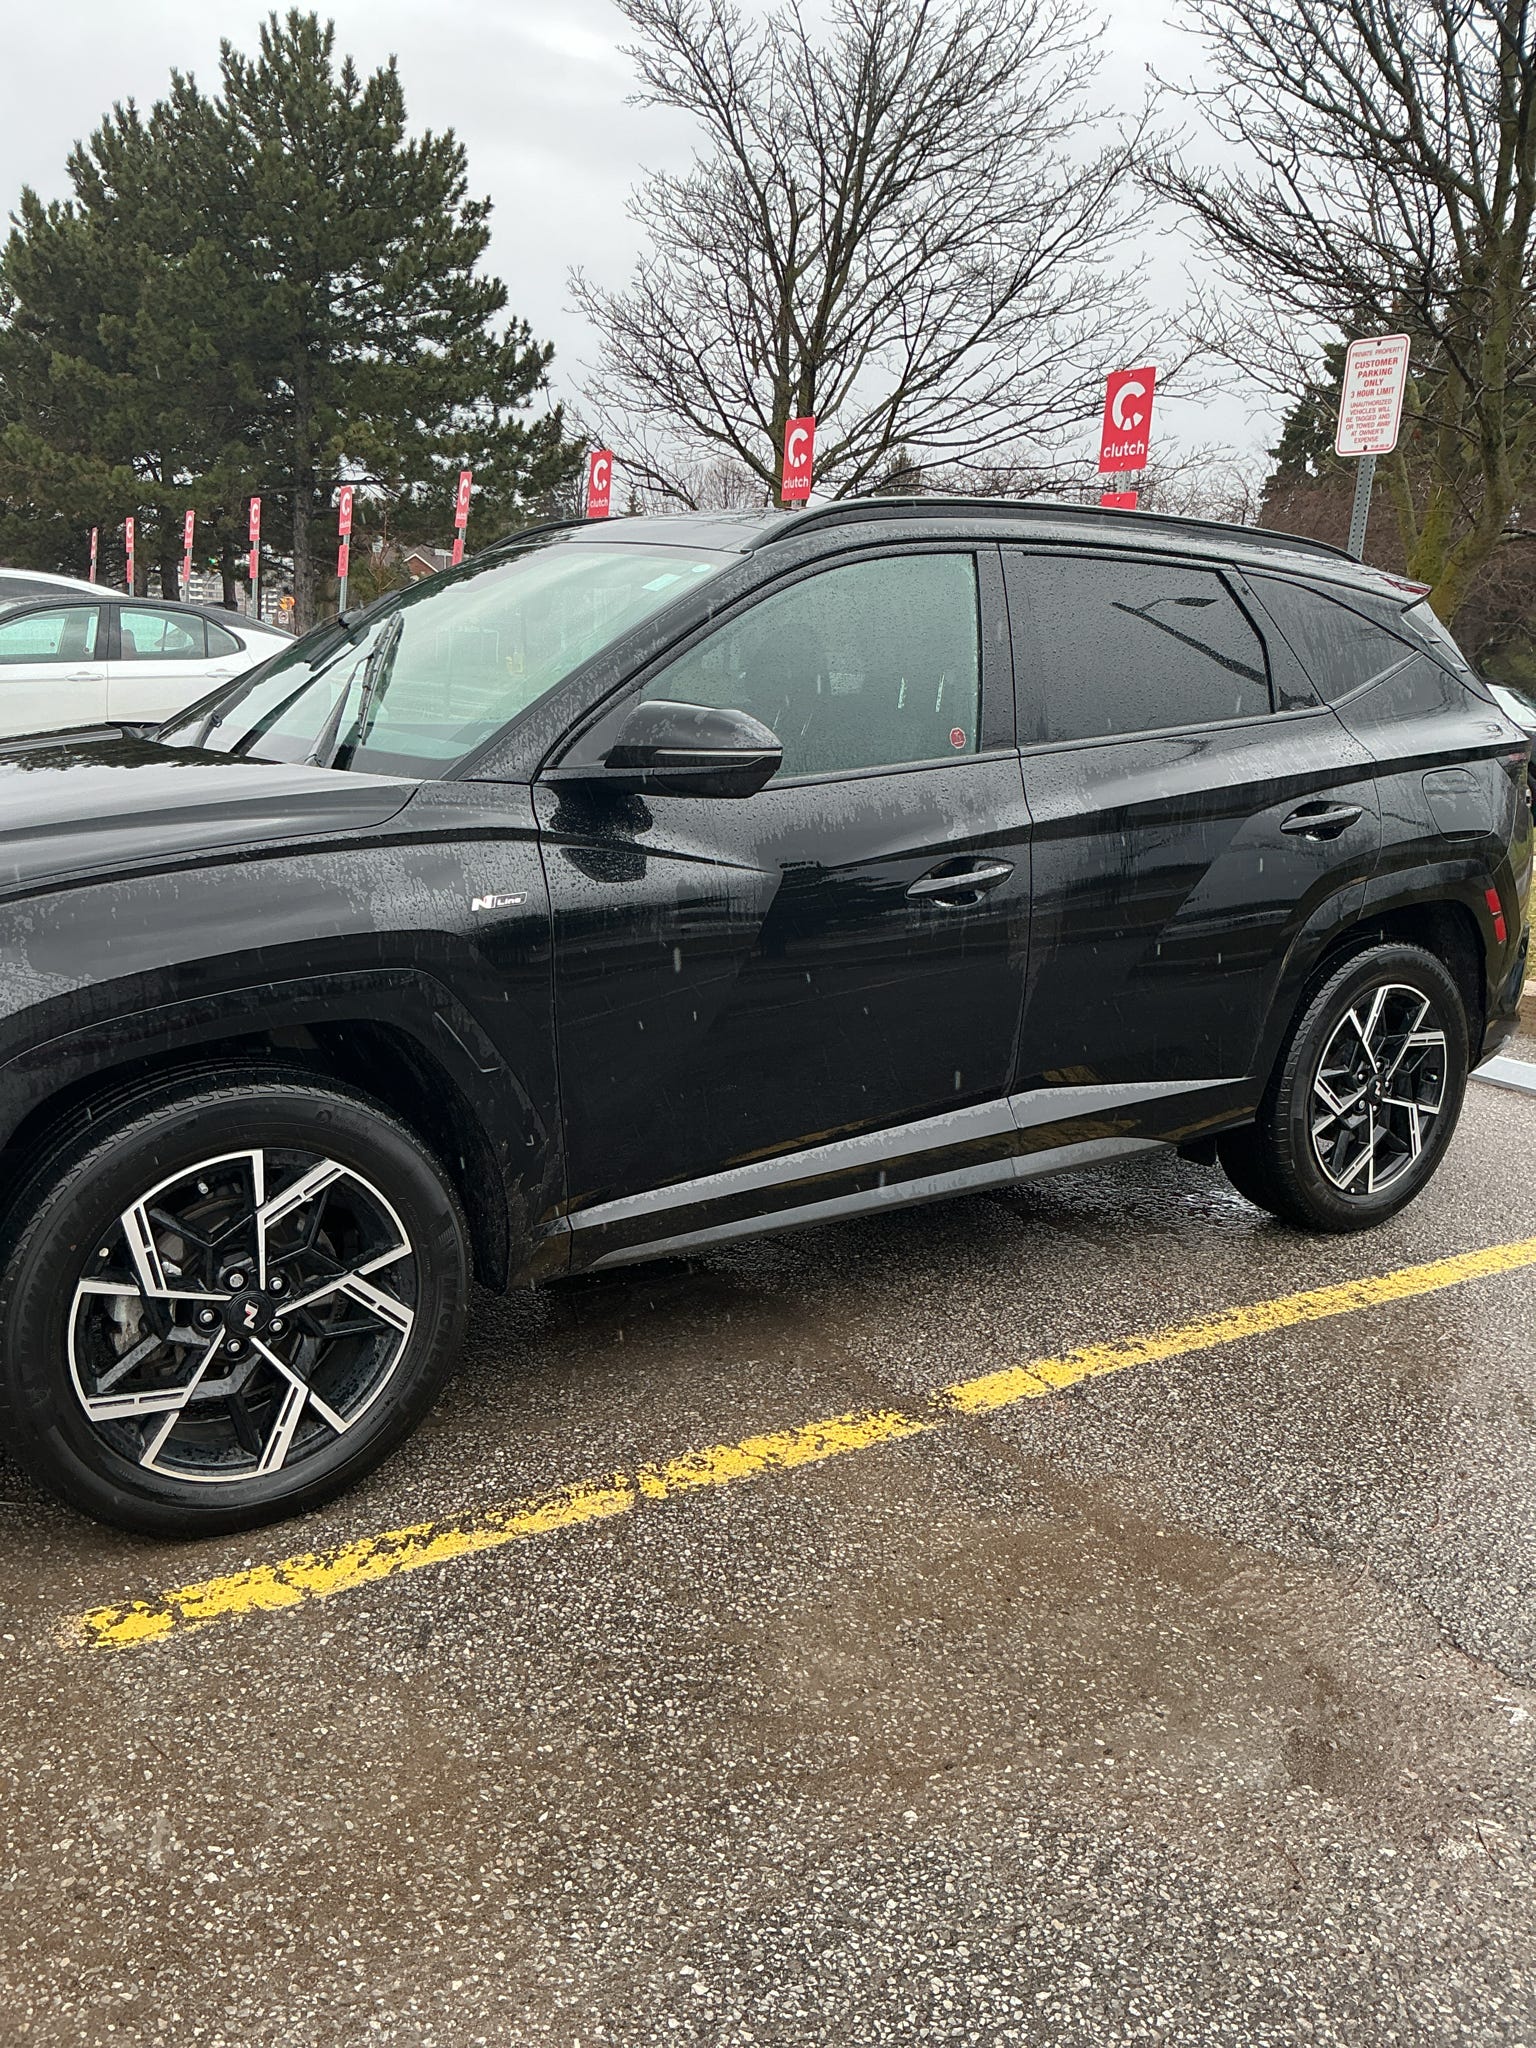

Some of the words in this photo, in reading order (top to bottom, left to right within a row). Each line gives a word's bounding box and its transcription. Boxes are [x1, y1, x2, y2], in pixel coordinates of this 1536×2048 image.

[1375, 346, 1404, 356] PROPERTY
[1354, 357, 1399, 370] CUSTOMER
[1357, 367, 1393, 379] PARKING
[1363, 377, 1384, 388] ONLY
[1350, 391, 1355, 399] 3
[1356, 388, 1375, 398] HOUR
[1376, 386, 1395, 396] LIMIT
[1350, 398, 1393, 408] UNAUTHORIZED
[1356, 421, 1376, 429] TOWED
[1103, 440, 1145, 458] clutch
[783, 475, 809, 489] clutch
